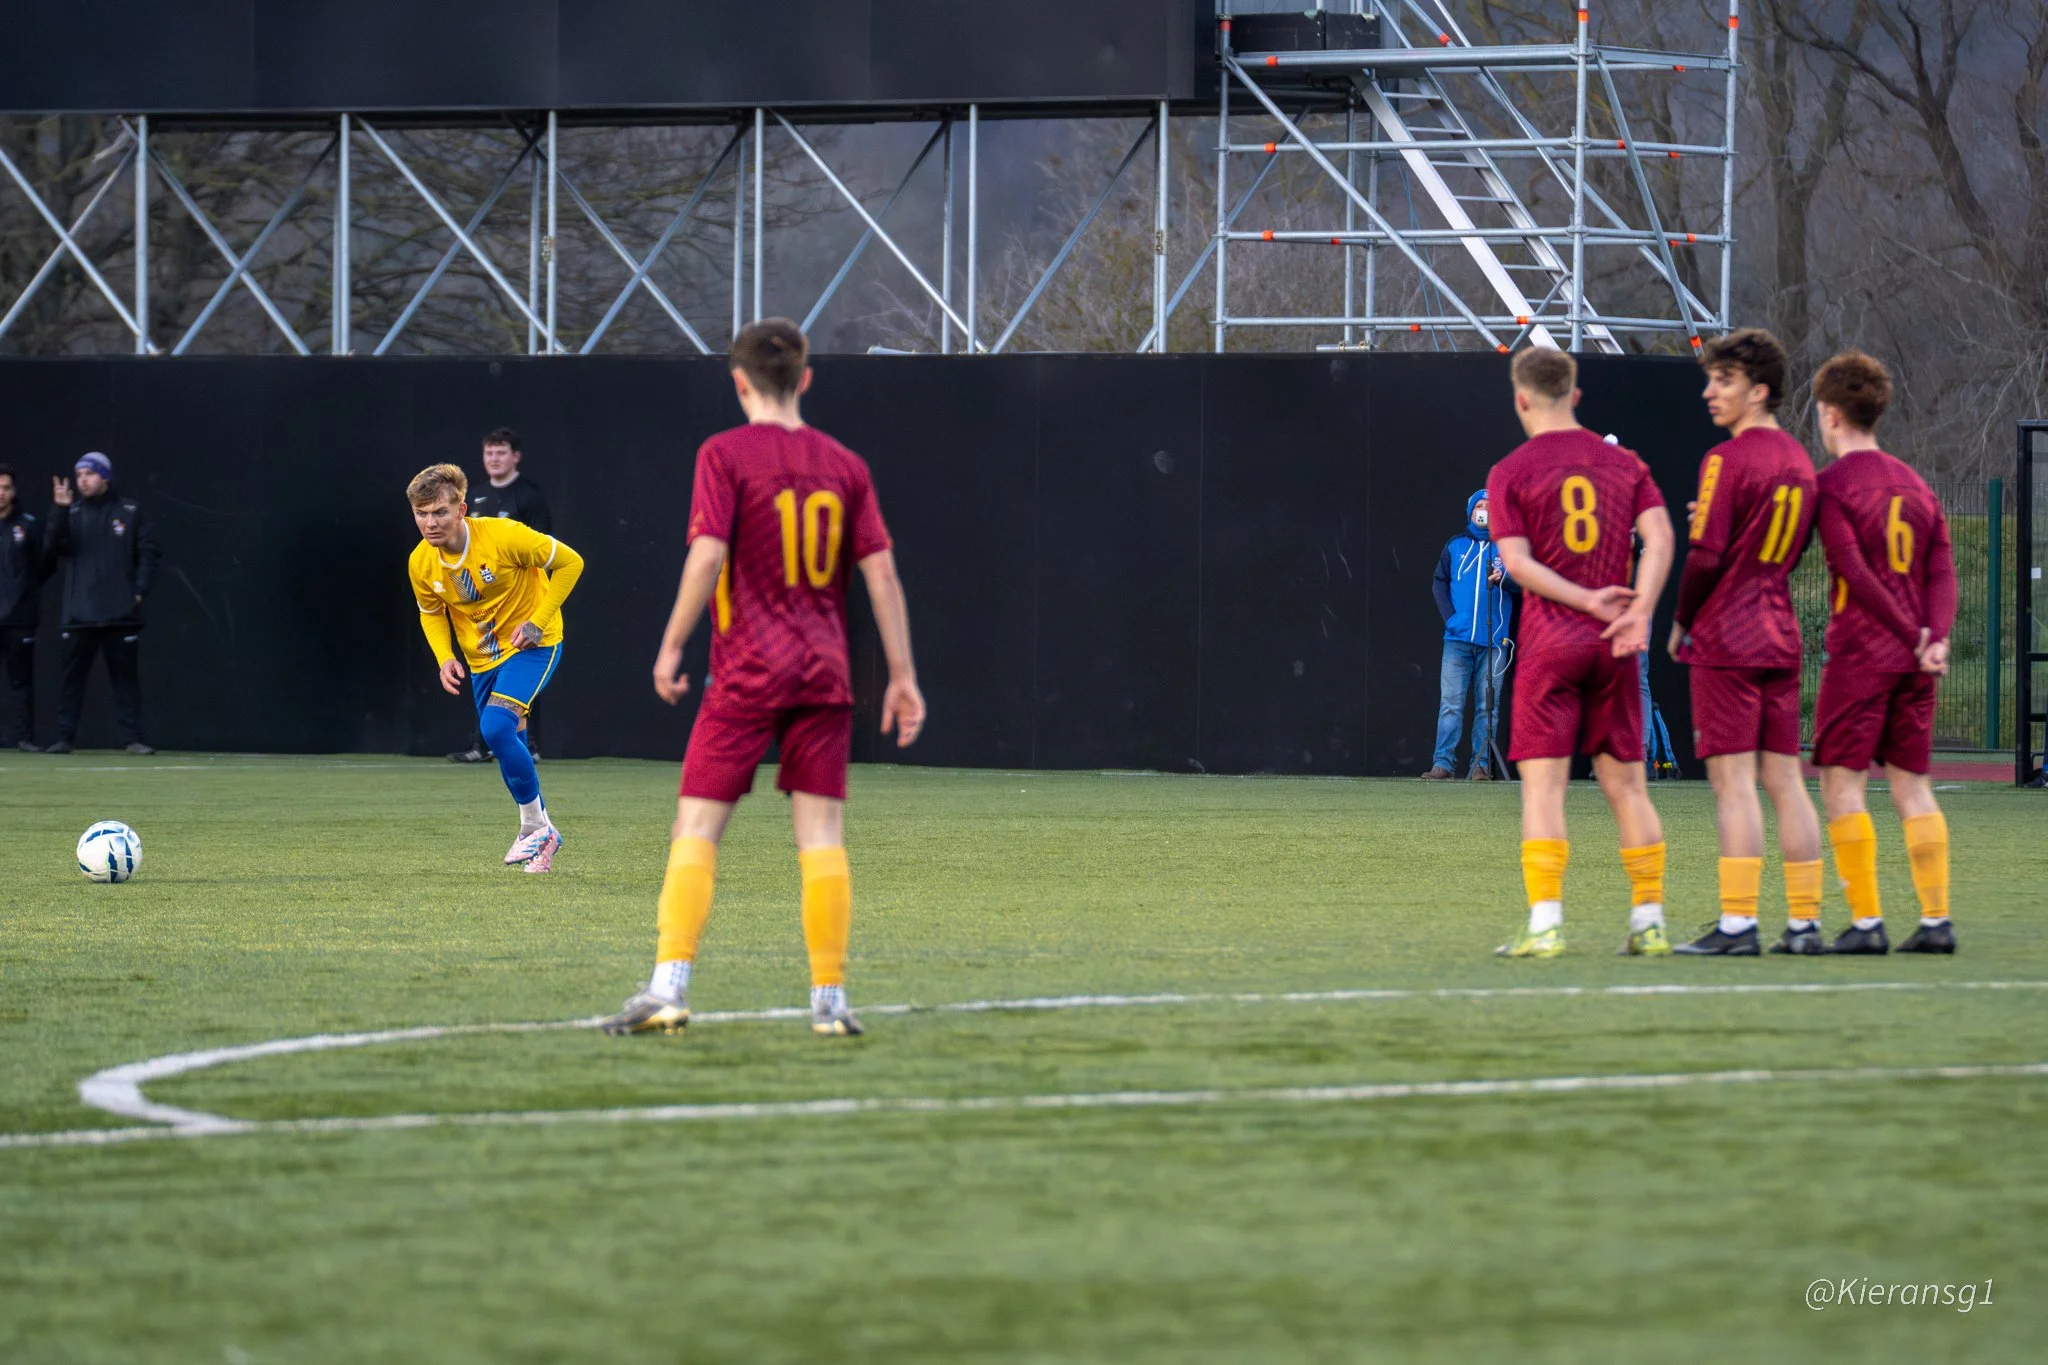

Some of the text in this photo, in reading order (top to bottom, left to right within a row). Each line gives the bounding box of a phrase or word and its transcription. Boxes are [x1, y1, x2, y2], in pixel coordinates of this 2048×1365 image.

[775, 489, 844, 587] 10
[1562, 475, 1599, 554] 8
[1759, 485, 1803, 565] 11
[1887, 496, 1914, 575] 6
